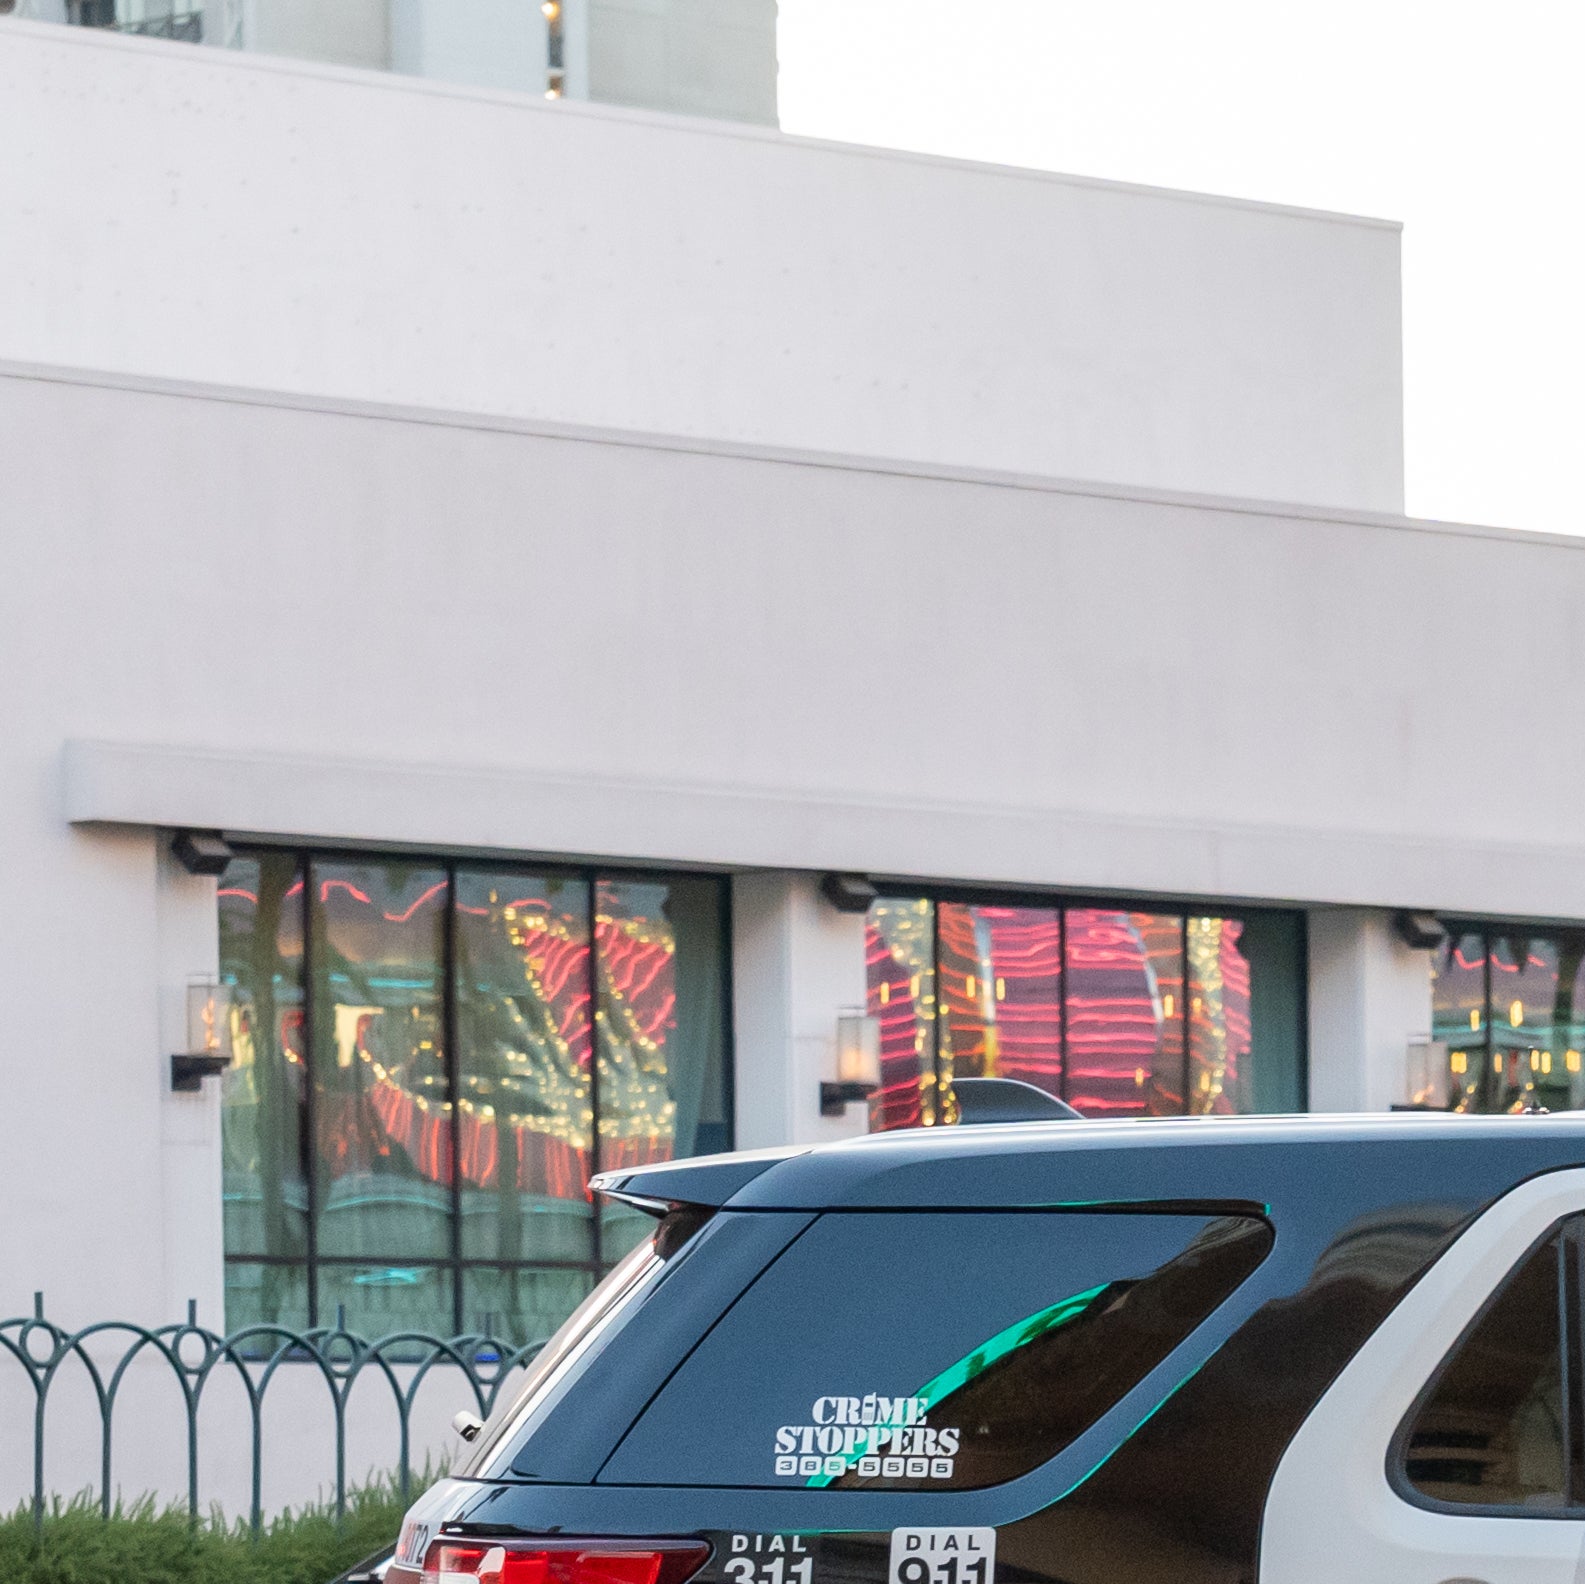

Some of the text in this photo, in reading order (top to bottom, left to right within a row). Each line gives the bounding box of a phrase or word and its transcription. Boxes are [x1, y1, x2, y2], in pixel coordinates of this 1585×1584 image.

[774, 1426, 960, 1457] STOPPERS
[776, 1457, 953, 1477] 385-5555
[732, 1534, 807, 1552] DIAL
[906, 1534, 981, 1551] DIAL
